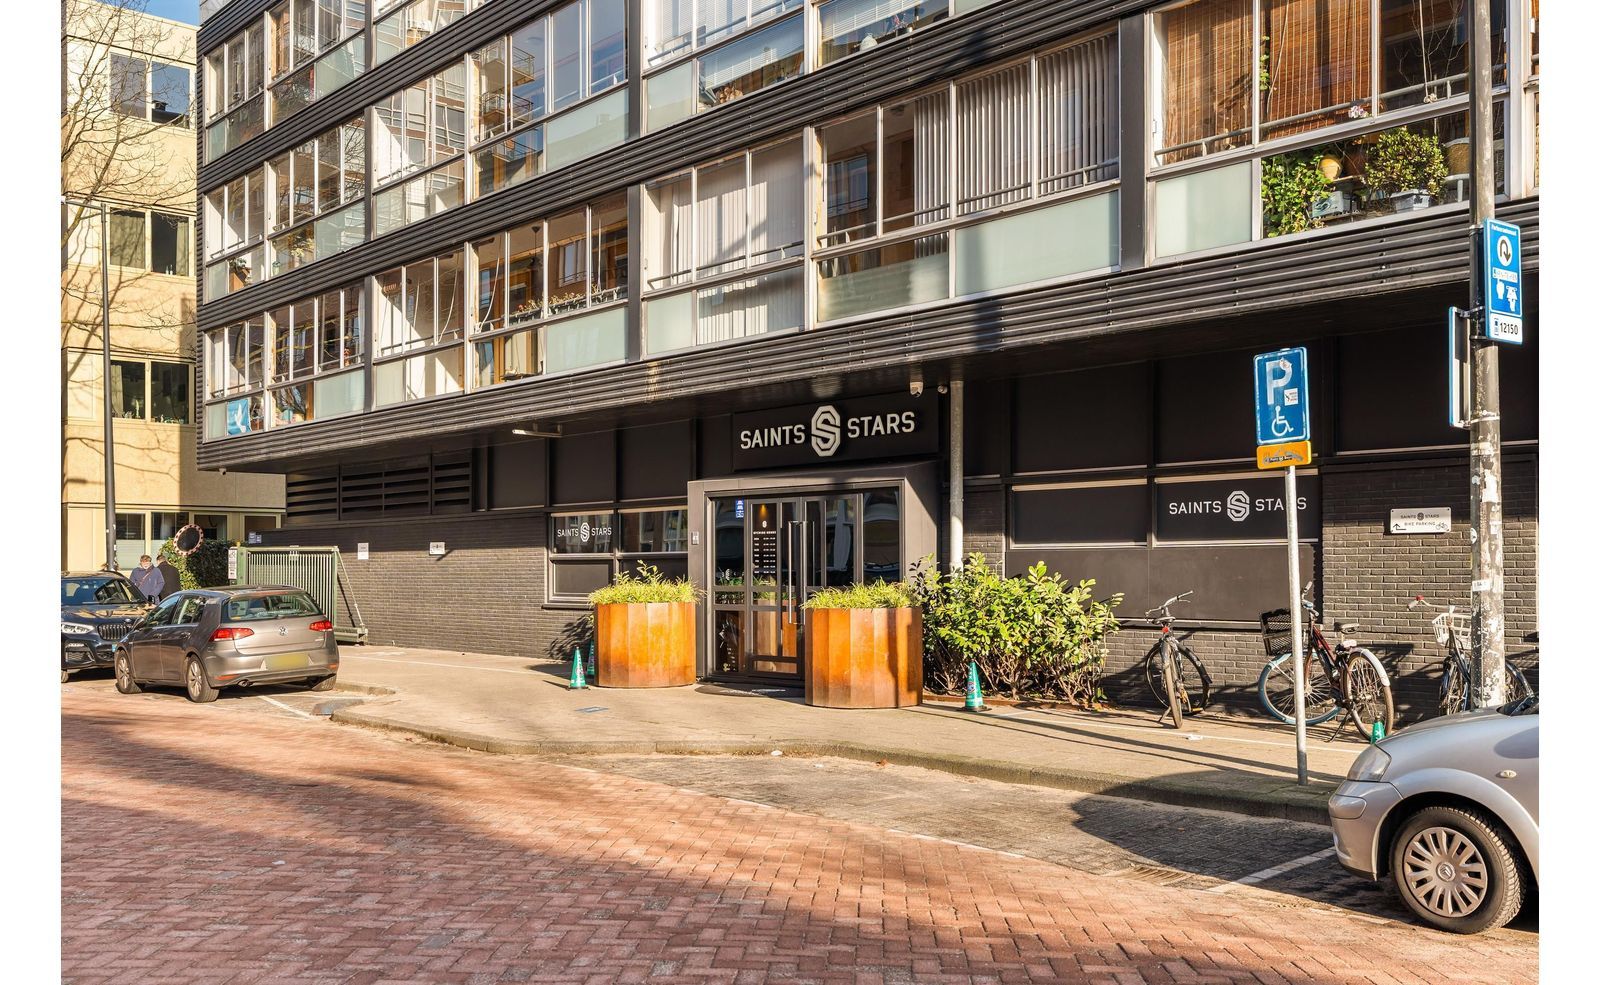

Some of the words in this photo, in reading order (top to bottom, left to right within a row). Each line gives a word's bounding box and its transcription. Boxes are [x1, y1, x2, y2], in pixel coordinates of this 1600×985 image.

[1500, 322, 1518, 335] 12150
[1266, 360, 1292, 405] P
[740, 424, 806, 450] SAINTS
[847, 411, 916, 438] STARS
[1169, 501, 1222, 515] SAINTS
[1255, 497, 1307, 511] STAS
[557, 528, 579, 537] SAINTS
[591, 527, 612, 536] STARS
